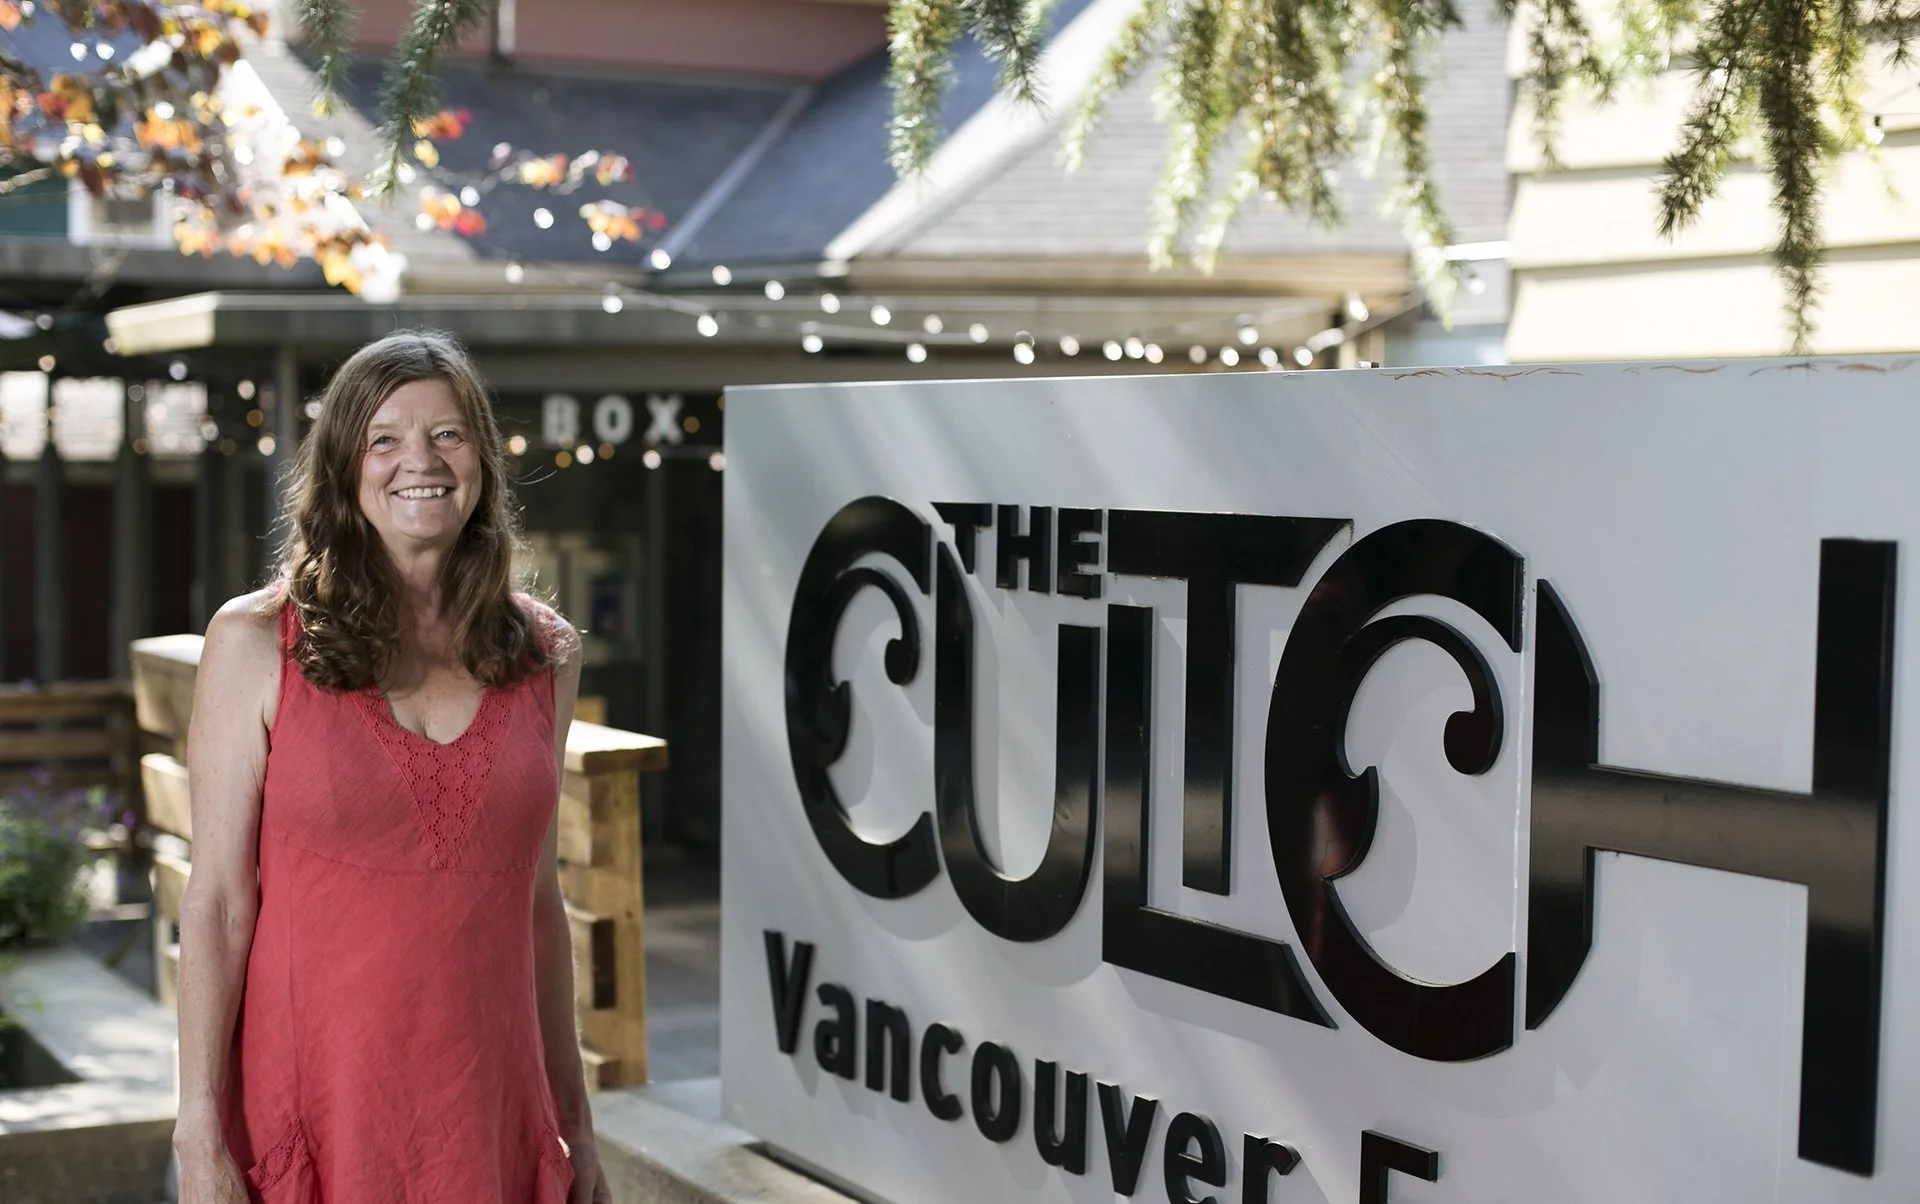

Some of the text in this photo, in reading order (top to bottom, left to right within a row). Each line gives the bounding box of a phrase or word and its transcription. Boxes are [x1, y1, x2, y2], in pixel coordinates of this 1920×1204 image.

[540, 394, 683, 445] BOX
[931, 501, 1103, 600] THE
[784, 495, 1898, 1178] CULTCH
[763, 929, 1301, 1204] Vancouver
